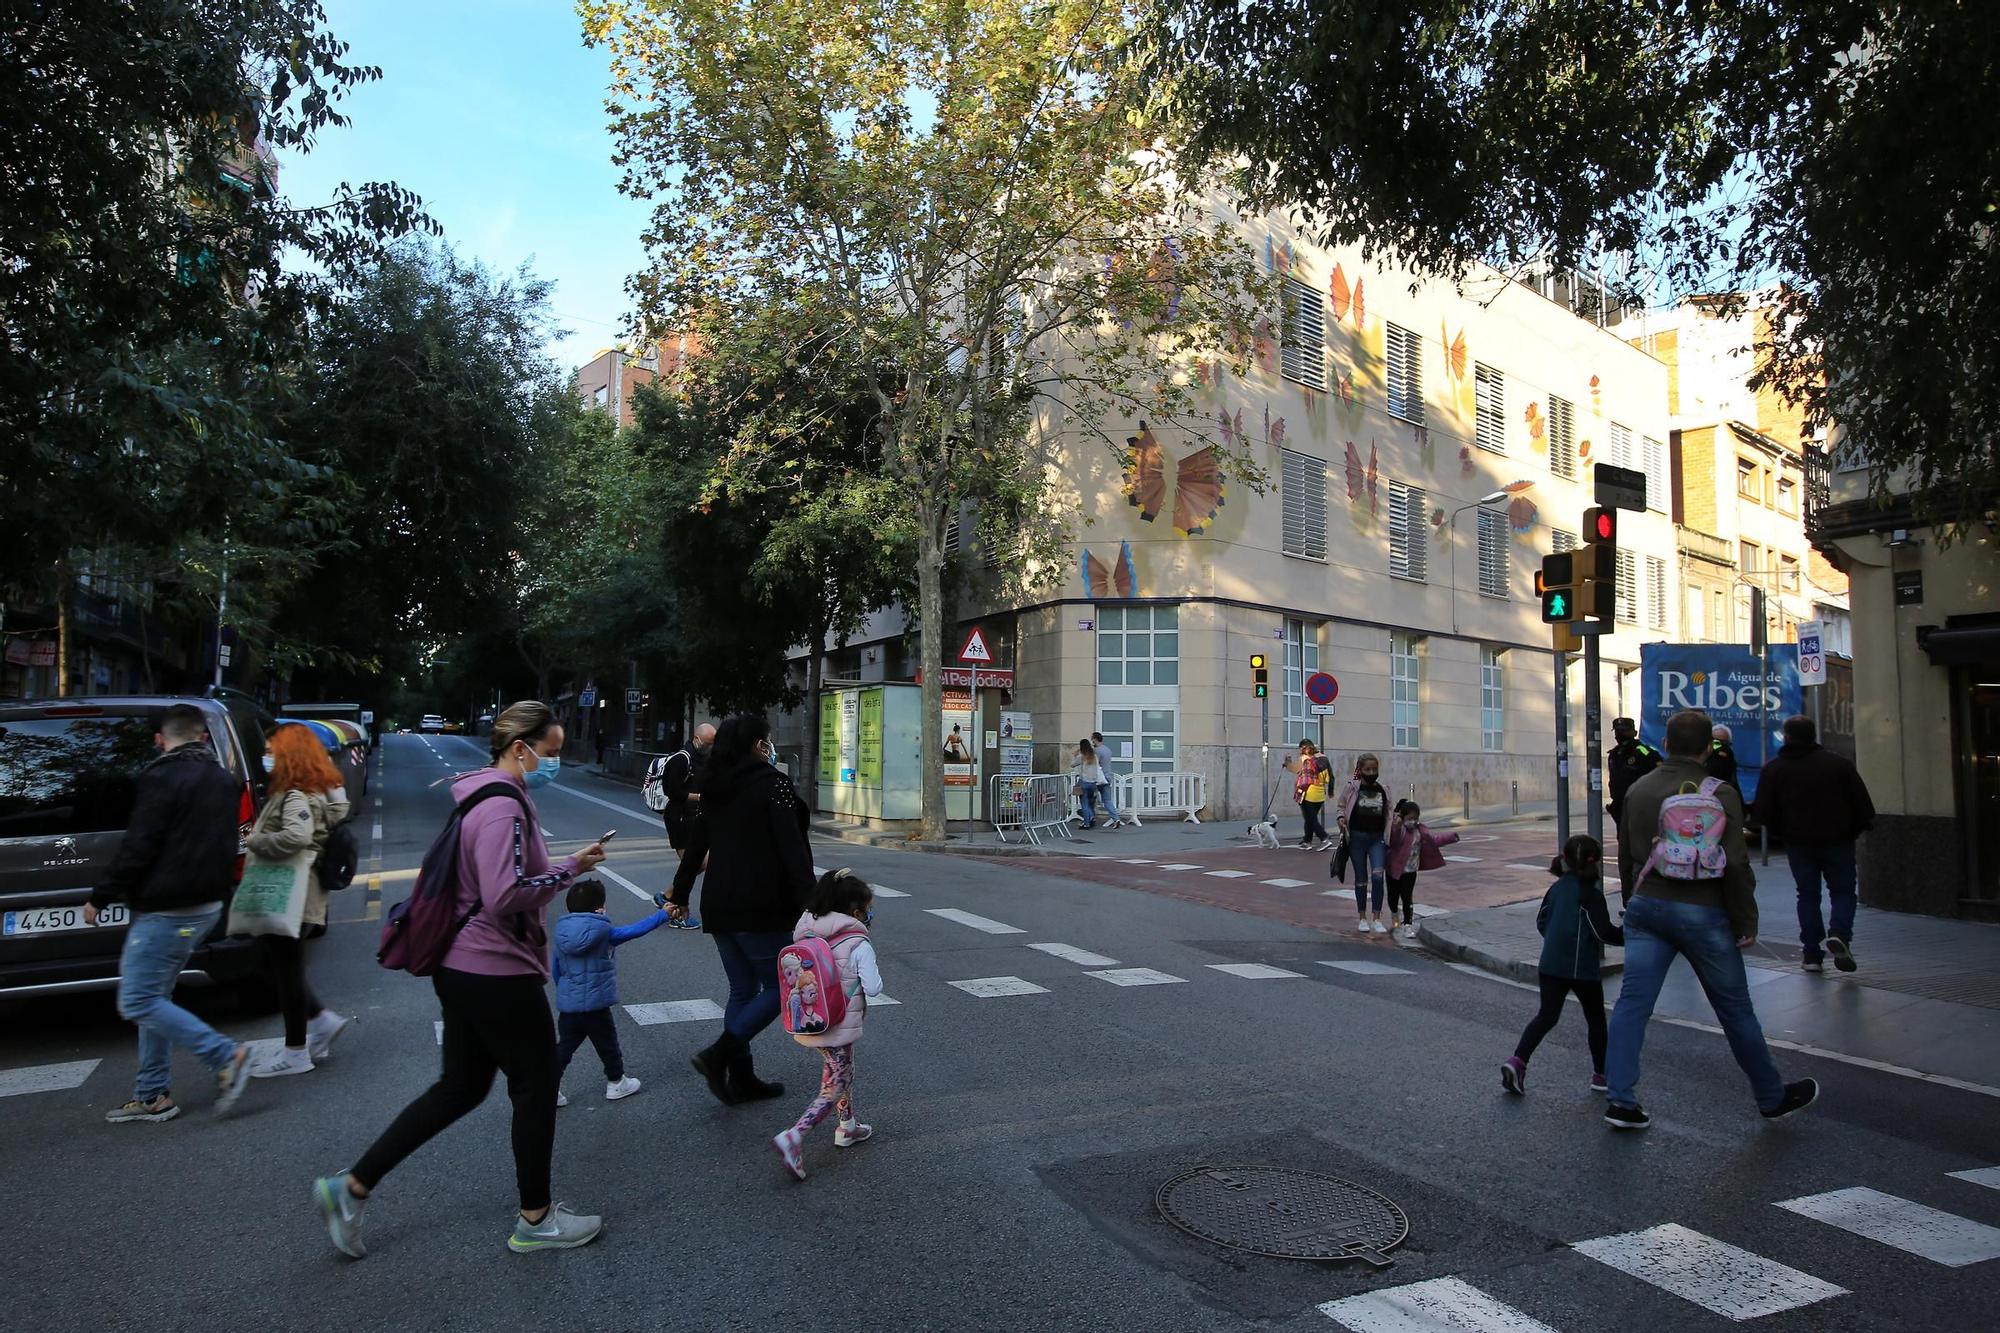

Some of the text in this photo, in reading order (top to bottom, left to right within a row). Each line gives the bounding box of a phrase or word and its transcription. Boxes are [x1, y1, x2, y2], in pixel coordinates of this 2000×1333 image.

[950, 672, 1013, 688] Peródico
[1728, 671, 1781, 684] Aigua de
[1657, 671, 1781, 711] Ribes
[1738, 711, 1780, 720] NATUAL
[21, 909, 77, 931] 4450
